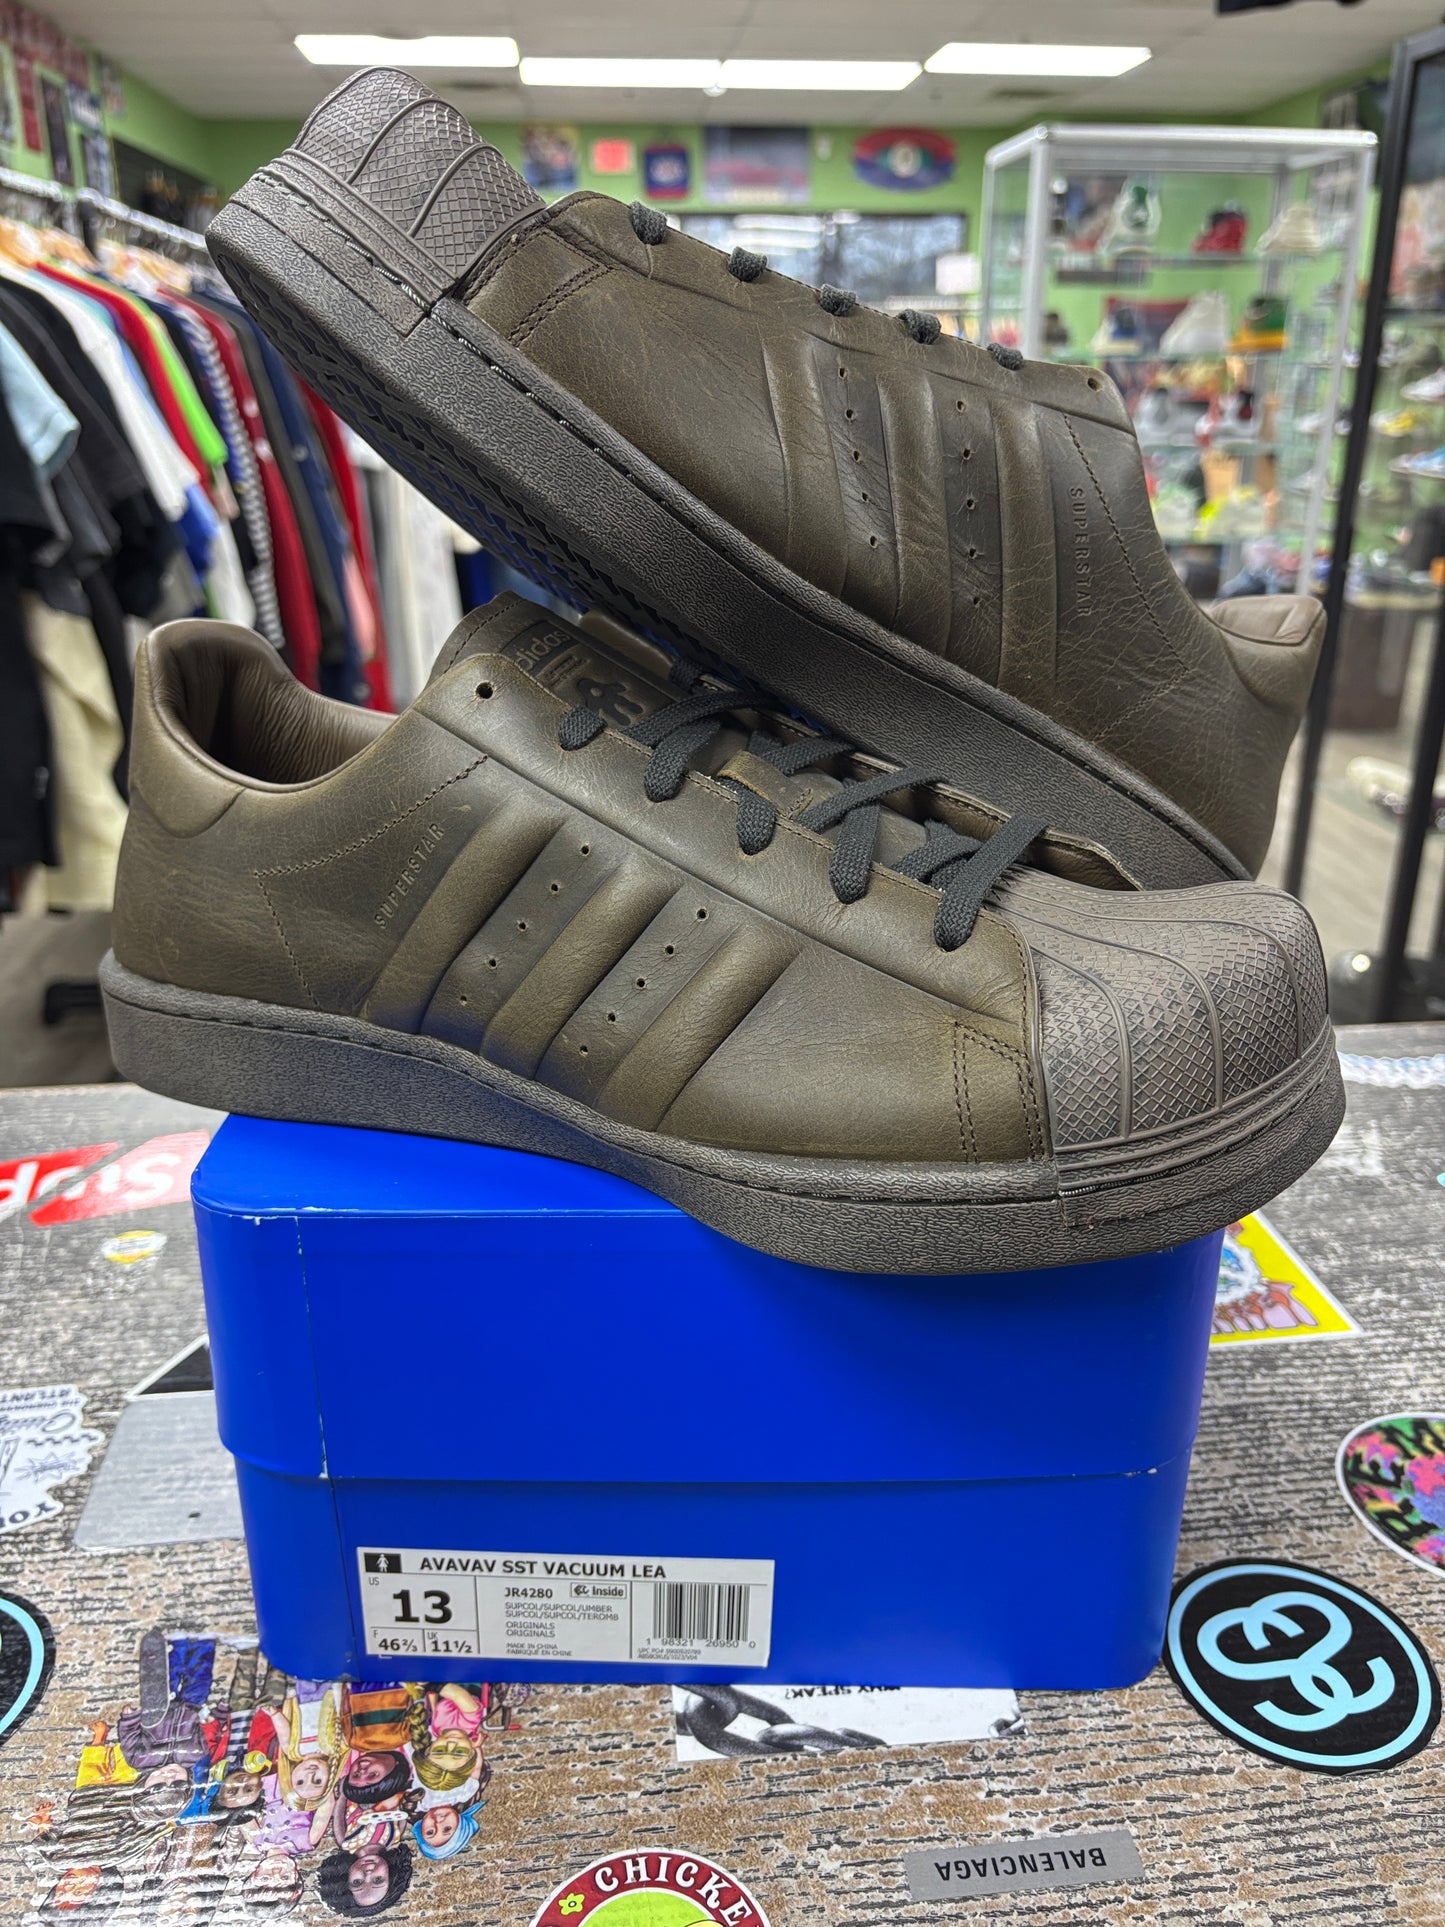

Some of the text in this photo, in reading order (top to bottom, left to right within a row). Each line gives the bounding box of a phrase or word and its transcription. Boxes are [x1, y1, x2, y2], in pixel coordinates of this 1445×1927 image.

[1070, 487, 1092, 617] SUPERSTAR
[515, 631, 571, 673] didas
[374, 823, 445, 929] SUPERSTAR
[0, 1501, 56, 1529] YO
[420, 1557, 666, 1579] AVAVAV SST VACUUM LEA
[369, 1577, 380, 1585] US
[592, 1586, 624, 1597] Inside
[504, 1587, 553, 1599] JR4280
[392, 1589, 453, 1624] 13
[427, 1632, 439, 1640] UK
[506, 1621, 555, 1630] ORIGINALS
[506, 1629, 556, 1638] ORIGINALS
[646, 1638, 651, 1646] 1
[749, 1641, 756, 1649] 0
[934, 1847, 1107, 1881] BALENCIAGA
[594, 1855, 753, 1927] CHICKE
